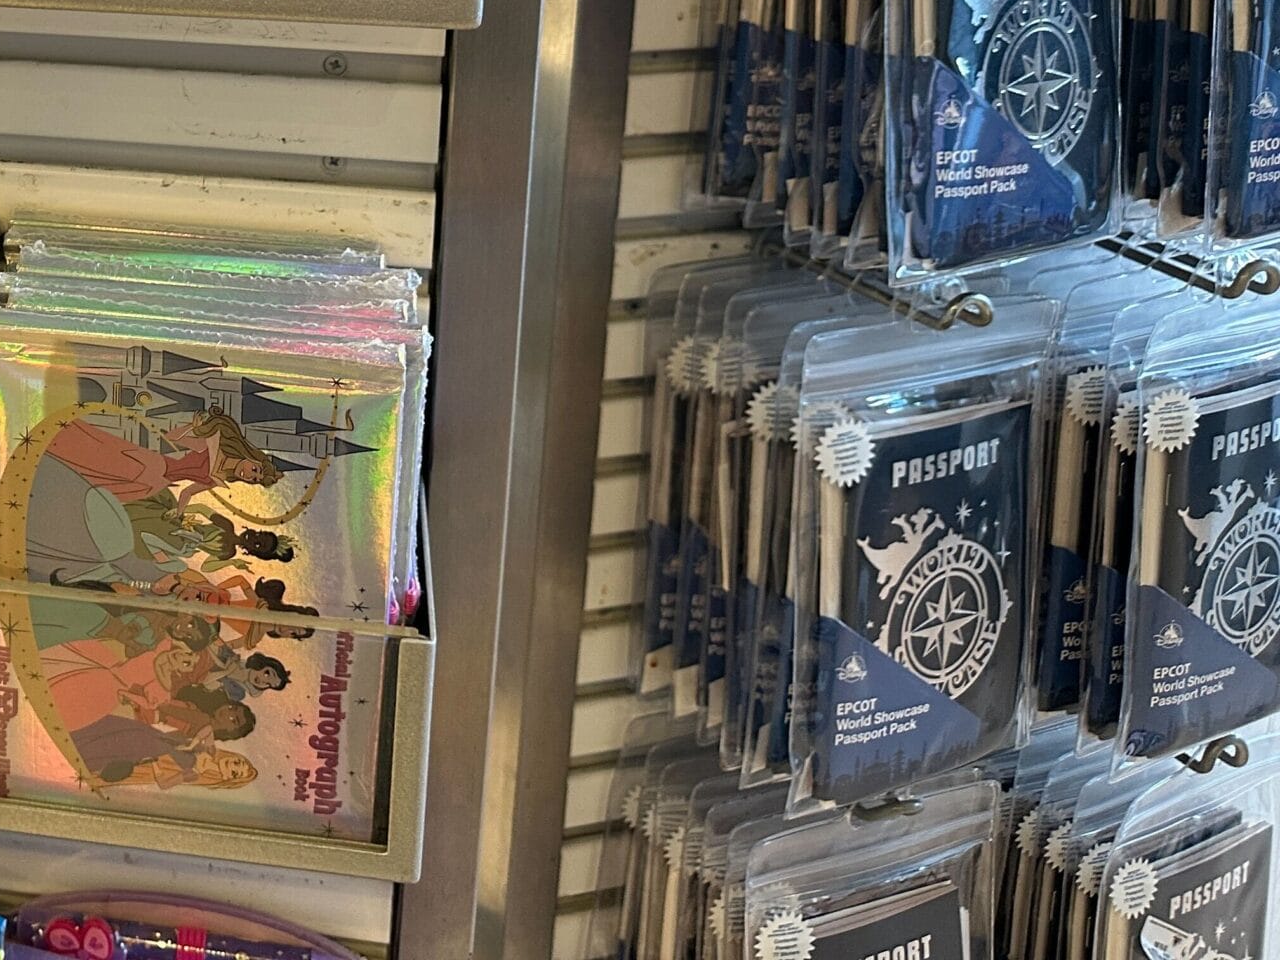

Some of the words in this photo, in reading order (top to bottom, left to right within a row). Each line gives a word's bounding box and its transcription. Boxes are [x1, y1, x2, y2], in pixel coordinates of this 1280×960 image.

[935, 149, 978, 165] EPCOT
[1249, 137, 1280, 153] EPCO
[936, 166, 972, 182] World
[974, 163, 1029, 179] Showcase
[1248, 171, 1280, 184] Passp
[934, 181, 989, 199] Passport
[990, 178, 1017, 193] Pack
[1211, 417, 1280, 461] PASSPO
[891, 437, 1000, 489] PASSPORT
[895, 543, 989, 605] WORLD
[334, 630, 355, 678] fficial
[1152, 662, 1192, 680] EPCOT
[1152, 676, 1186, 694] World
[1187, 665, 1237, 687] Showcase
[836, 697, 878, 716] EPCOT
[1149, 689, 1199, 708] Passport
[1199, 681, 1224, 698] Pack
[836, 714, 872, 731] World
[873, 703, 931, 724] Showcase
[308, 674, 348, 815] Autograph
[834, 725, 888, 746] Passport
[889, 718, 918, 735] Pack
[1170, 860, 1251, 921] PASSPORT
